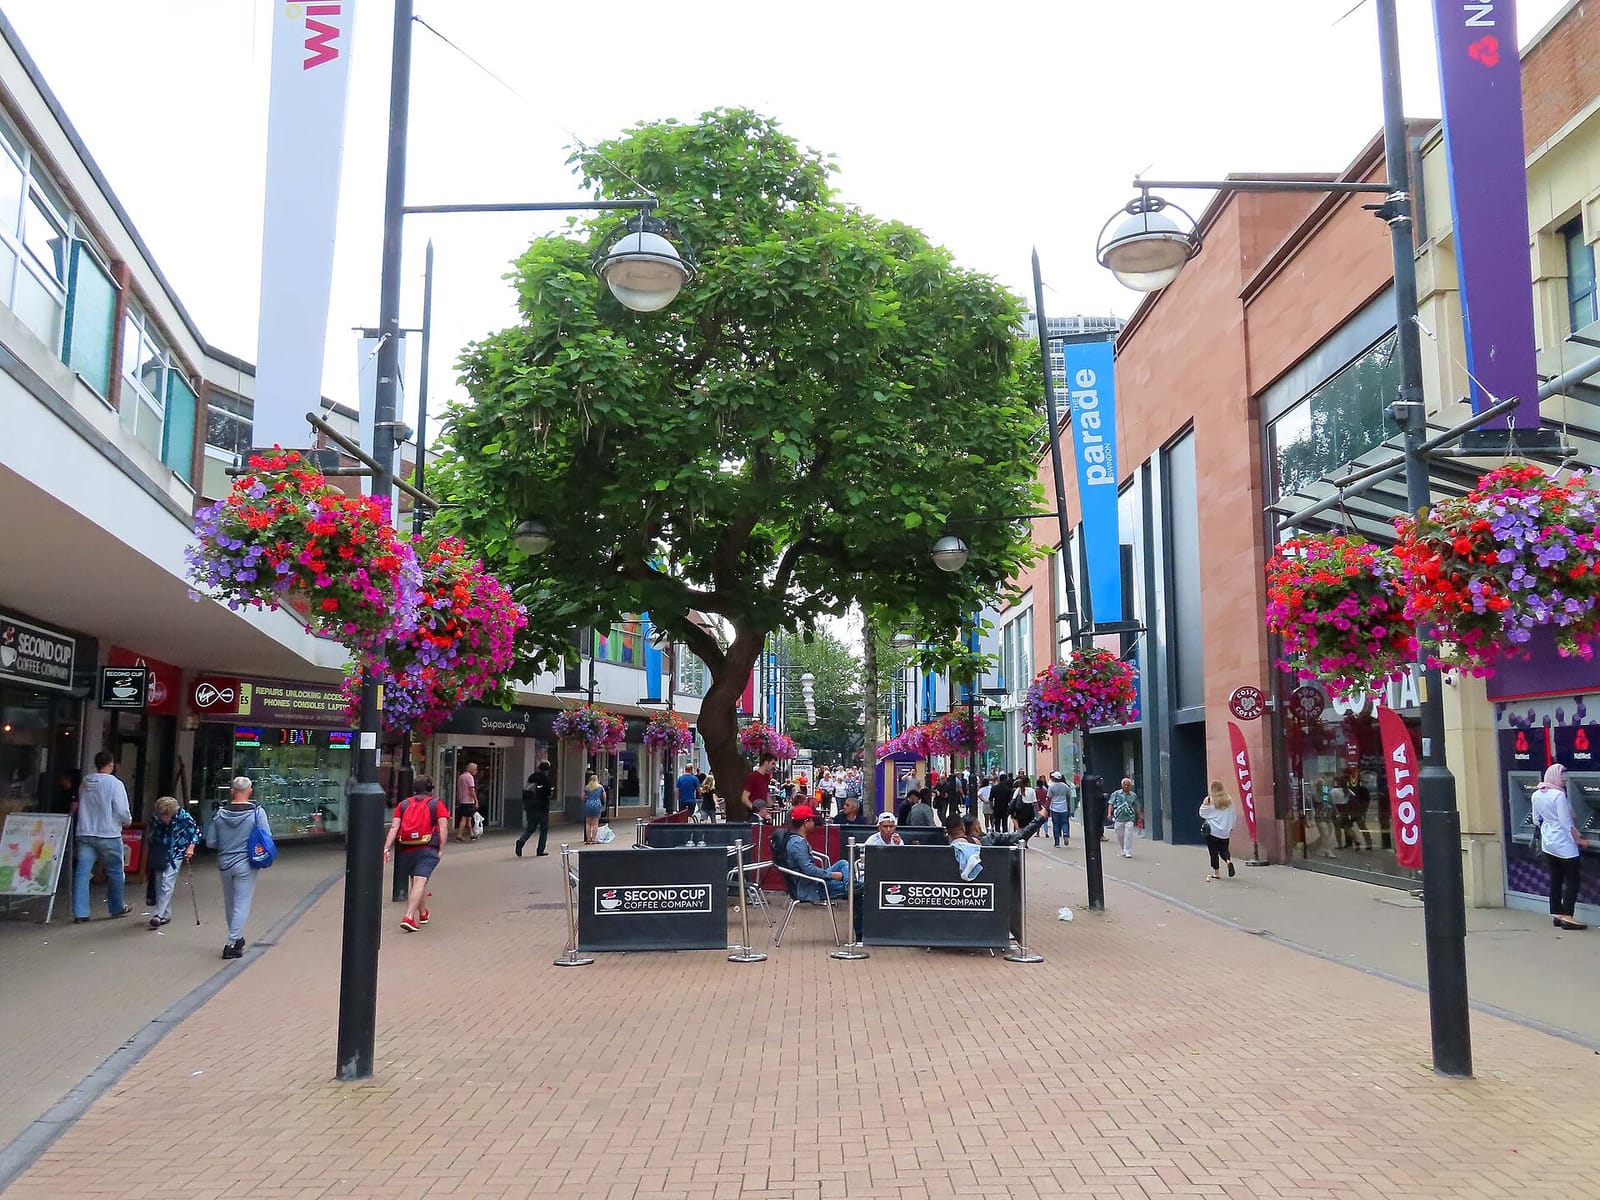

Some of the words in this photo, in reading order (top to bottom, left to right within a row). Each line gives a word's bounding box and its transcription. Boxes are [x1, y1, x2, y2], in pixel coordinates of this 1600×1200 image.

[1463, 0, 1496, 27] N
[286, 0, 341, 70] wi
[1072, 368, 1115, 485] parade
[18, 632, 54, 661] SECOND
[54, 644, 72, 664] CUP
[16, 655, 40, 675] COFFEE
[198, 687, 215, 703] Virgin
[255, 686, 283, 696] REPAIRS
[286, 689, 321, 699] UNLOCKING
[1237, 690, 1258, 698] COSTA
[263, 698, 290, 707] PHONES
[293, 700, 325, 710] CONSOLES
[1235, 706, 1261, 717] COFFEE
[481, 716, 526, 733] Superdrug
[1392, 743, 1419, 845] COSTA
[624, 890, 677, 901] SECOND
[679, 889, 706, 900] CUP
[908, 886, 960, 898] SECOND
[962, 887, 988, 898] CUP
[623, 901, 658, 909] COFFEE
[660, 900, 704, 909] COMPANY
[907, 897, 942, 906] COFFEE
[943, 898, 986, 906] COMPANY
